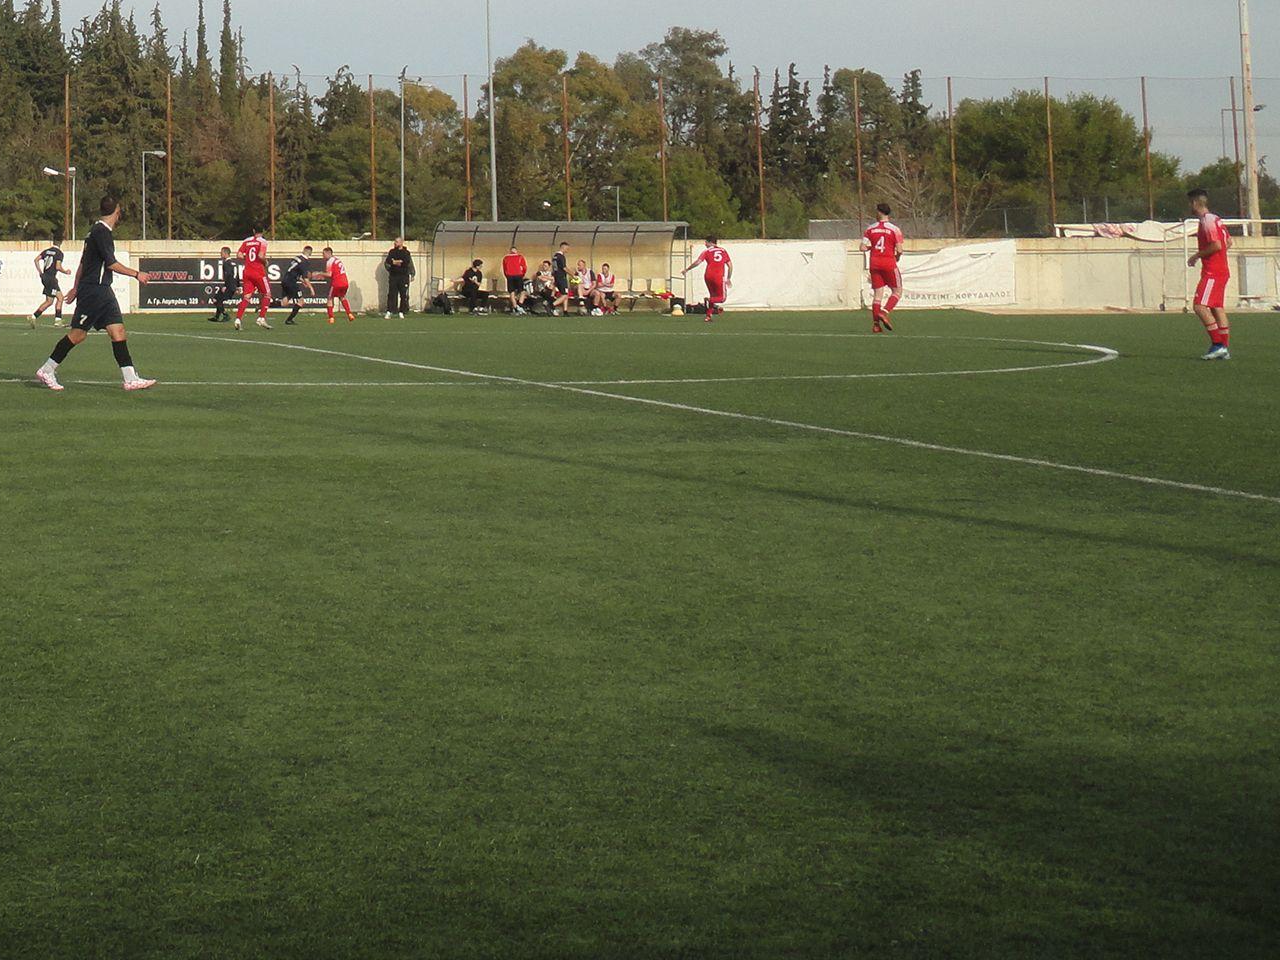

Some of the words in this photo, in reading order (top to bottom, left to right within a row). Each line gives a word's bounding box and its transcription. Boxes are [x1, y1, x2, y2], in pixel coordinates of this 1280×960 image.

[874, 235, 886, 253] 4
[248, 246, 257, 262] 6
[713, 250, 723, 262] 5
[79, 314, 88, 325] 7
